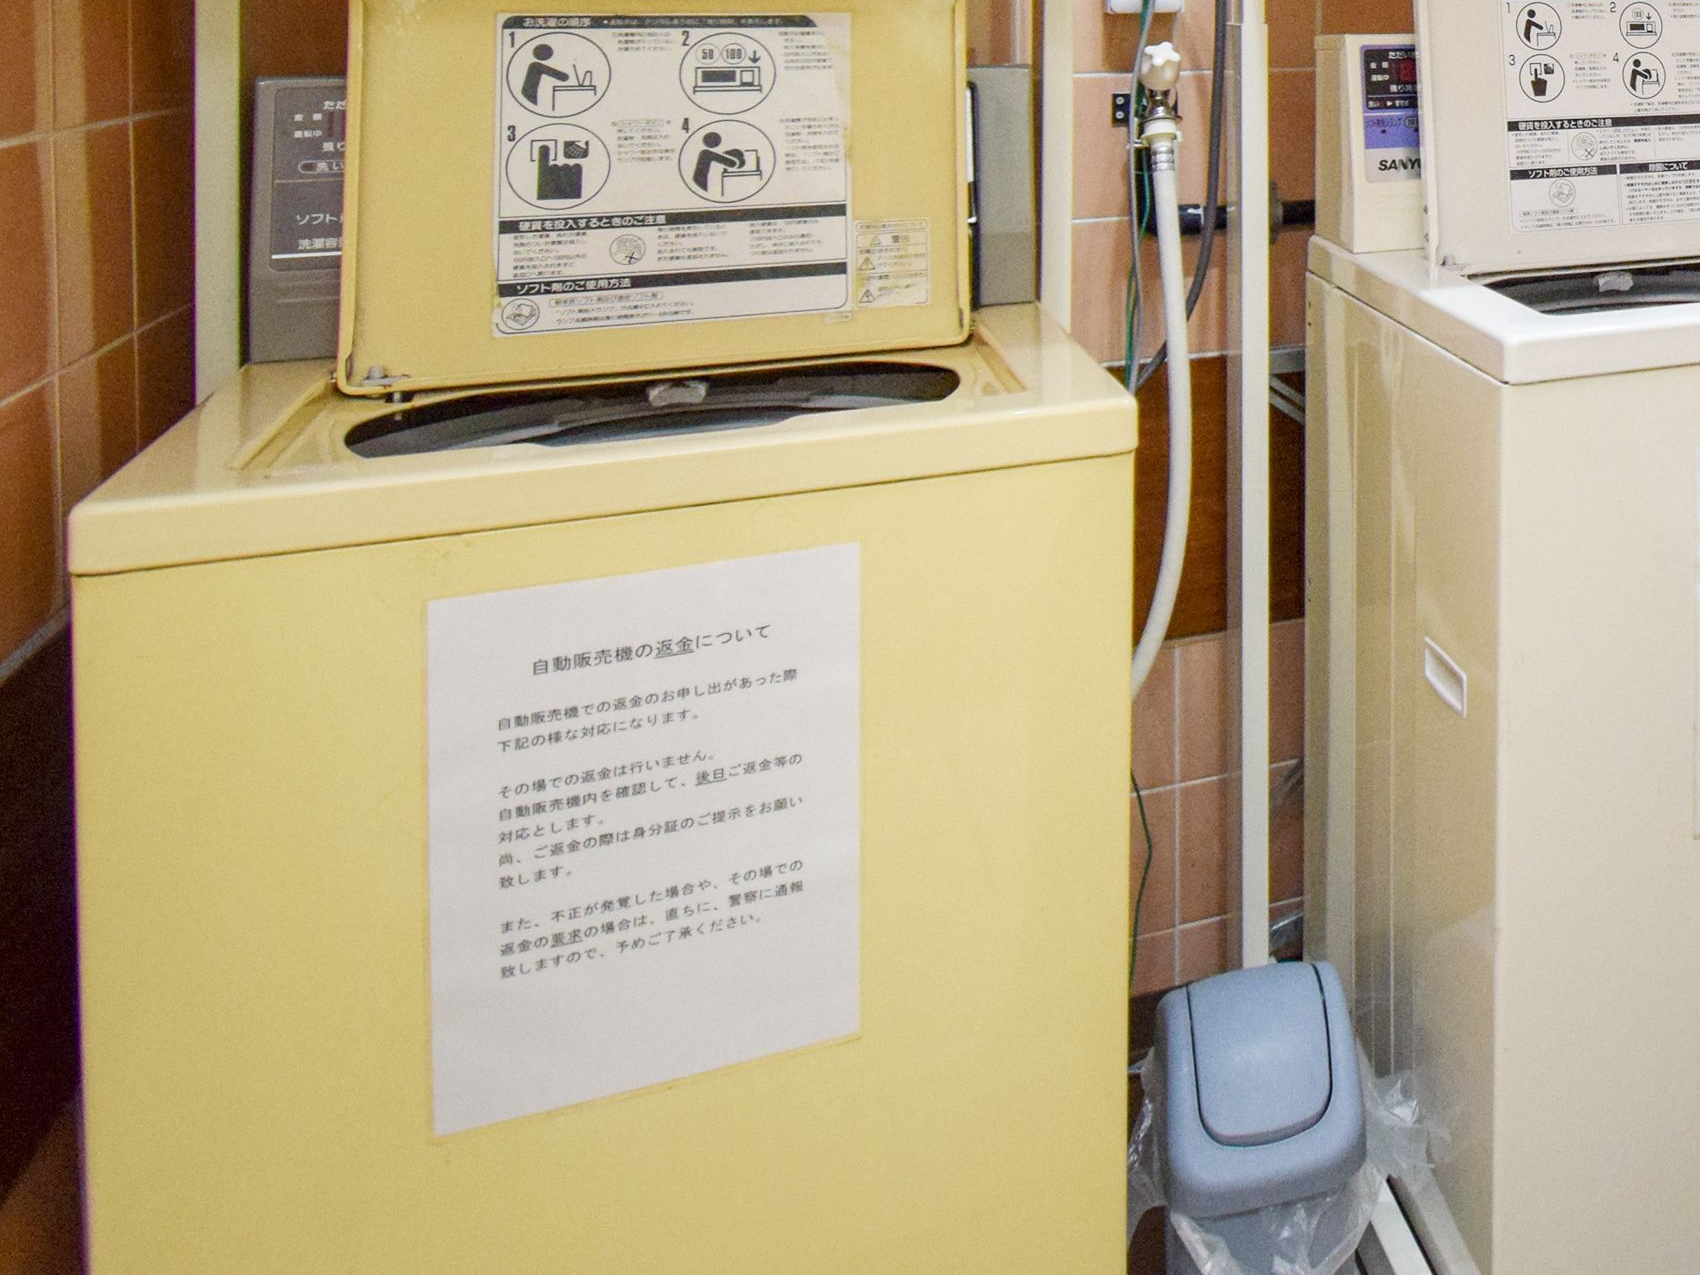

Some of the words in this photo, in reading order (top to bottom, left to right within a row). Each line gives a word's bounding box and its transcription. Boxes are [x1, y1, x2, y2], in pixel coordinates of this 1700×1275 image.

[1609, 1, 1616, 13] 2
[508, 31, 516, 48] 1
[681, 30, 690, 46] 2
[1508, 54, 1516, 66] 3
[1612, 52, 1620, 63] 4
[507, 125, 516, 142] 3
[681, 117, 690, 133] 4
[532, 624, 771, 676] 自動販売機の返金について
[497, 668, 798, 731] 自動販売機での返金のお申し出があった際
[497, 708, 699, 753] 下記の様な対応になります。
[498, 749, 714, 799] その場での返金は行いません。
[498, 814, 604, 844] 対応とします。
[499, 865, 572, 889] 致します。
